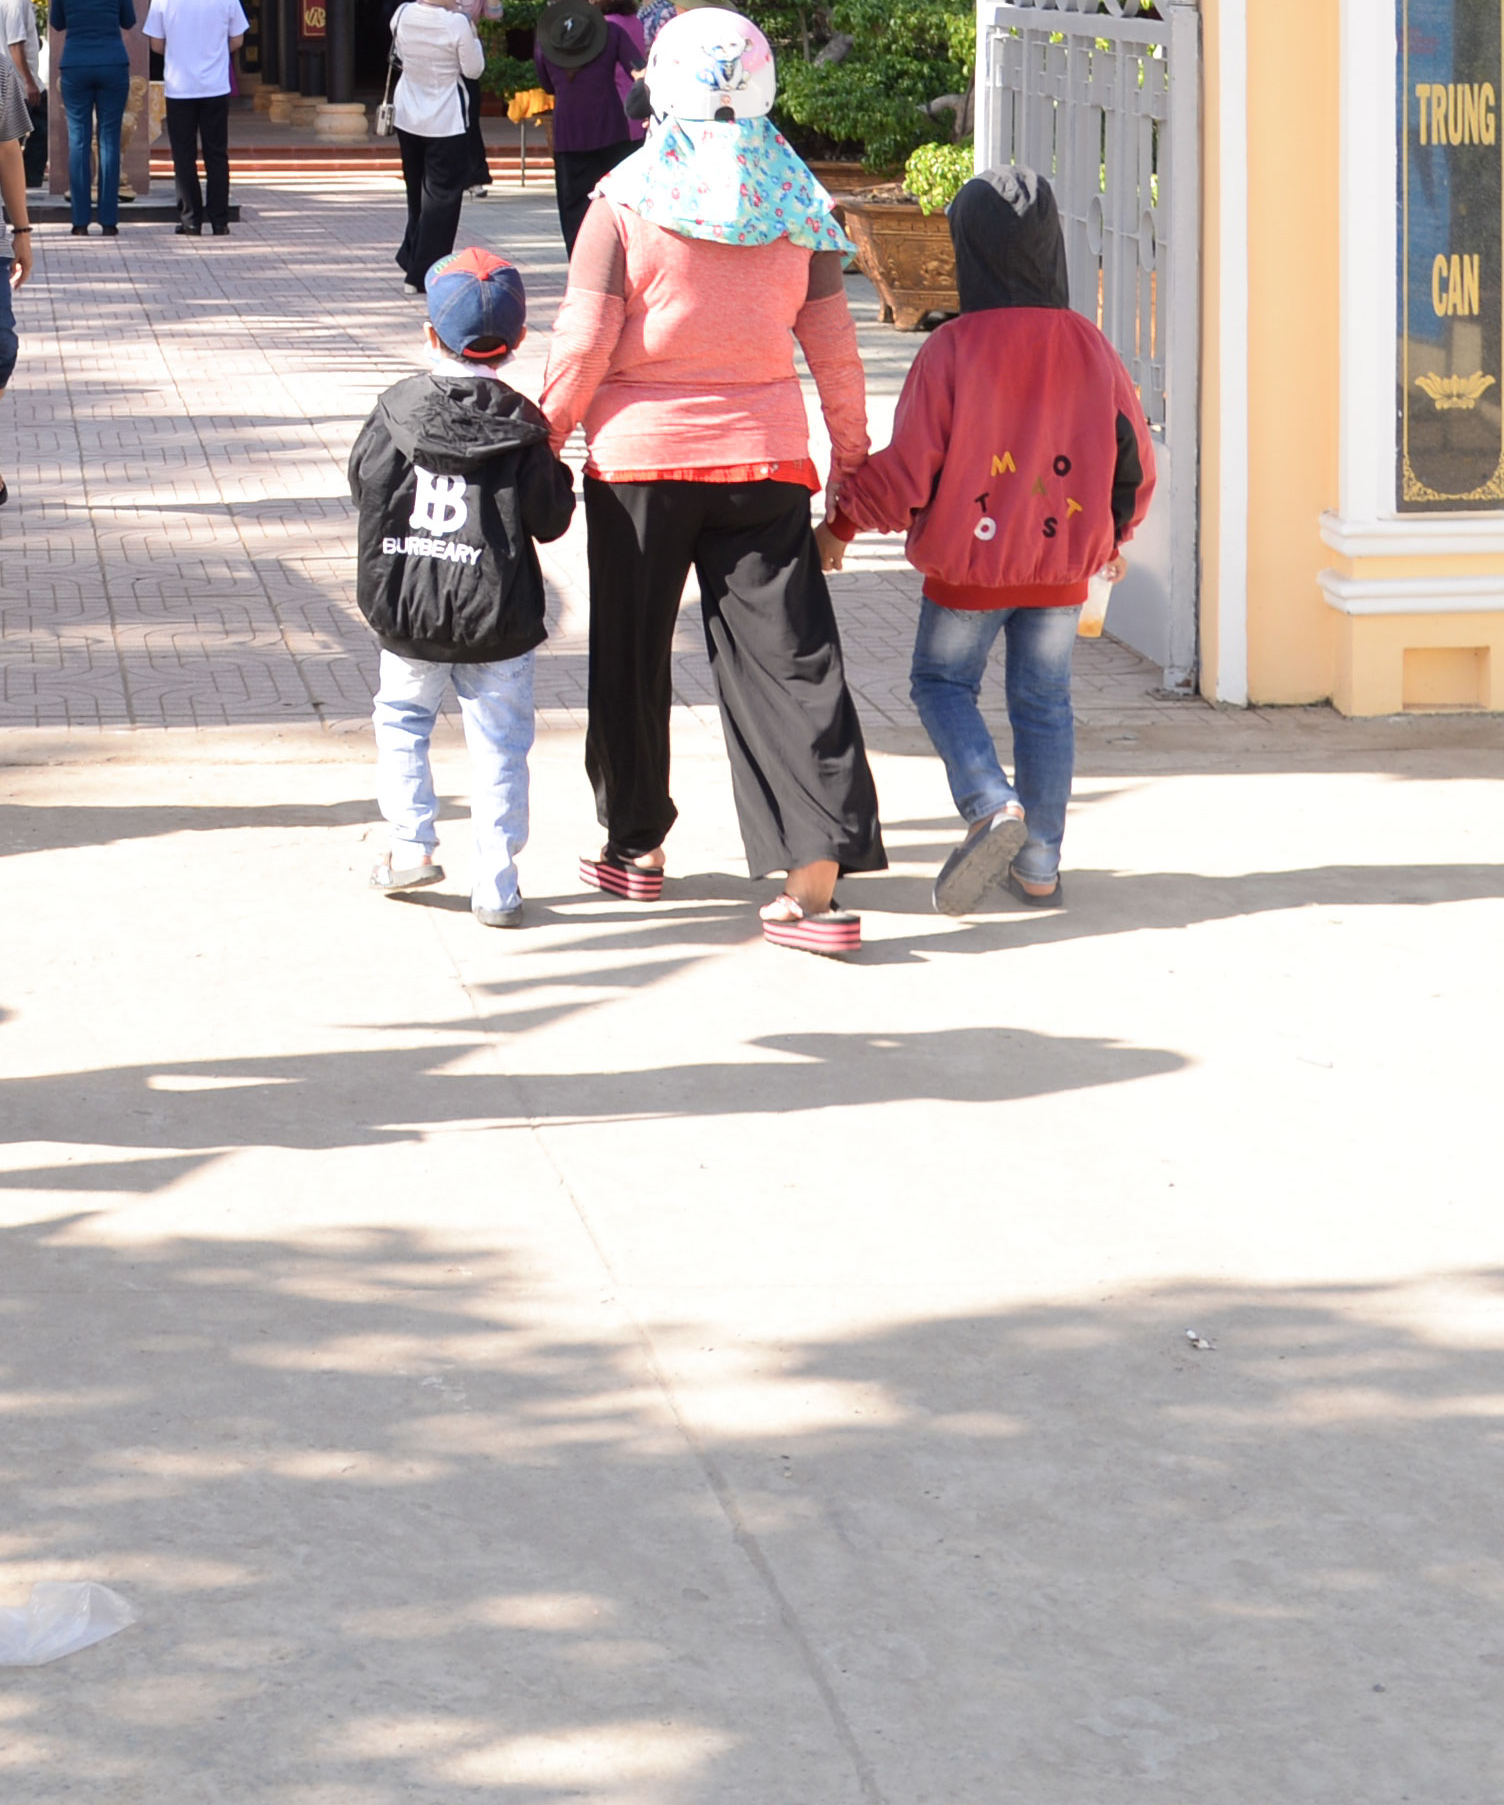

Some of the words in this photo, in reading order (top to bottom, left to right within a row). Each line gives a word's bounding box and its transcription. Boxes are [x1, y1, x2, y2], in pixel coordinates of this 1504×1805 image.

[1416, 81, 1496, 146] TRUNG
[1432, 253, 1480, 316] CAN
[382, 536, 483, 566] BURBEARY
